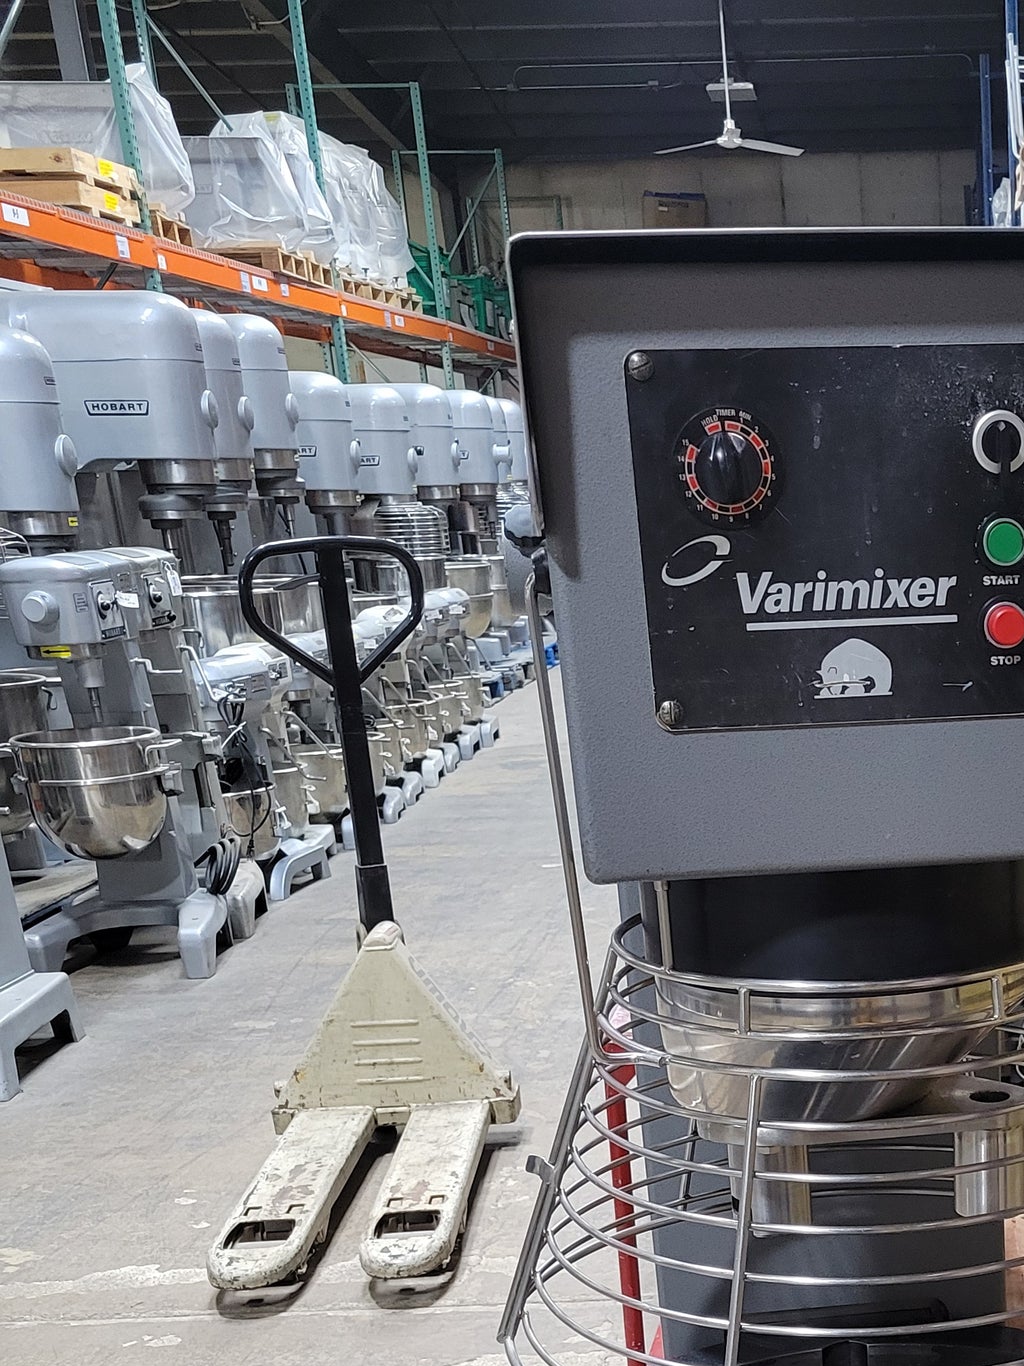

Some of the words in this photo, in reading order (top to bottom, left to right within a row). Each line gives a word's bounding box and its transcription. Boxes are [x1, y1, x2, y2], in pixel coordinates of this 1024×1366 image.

[91, 402, 144, 412] HOBART
[715, 409, 736, 417] TIMER
[701, 415, 718, 426] HOLD
[982, 574, 1021, 587] START
[736, 569, 957, 615] Varimixer
[990, 654, 1021, 666] STOP
